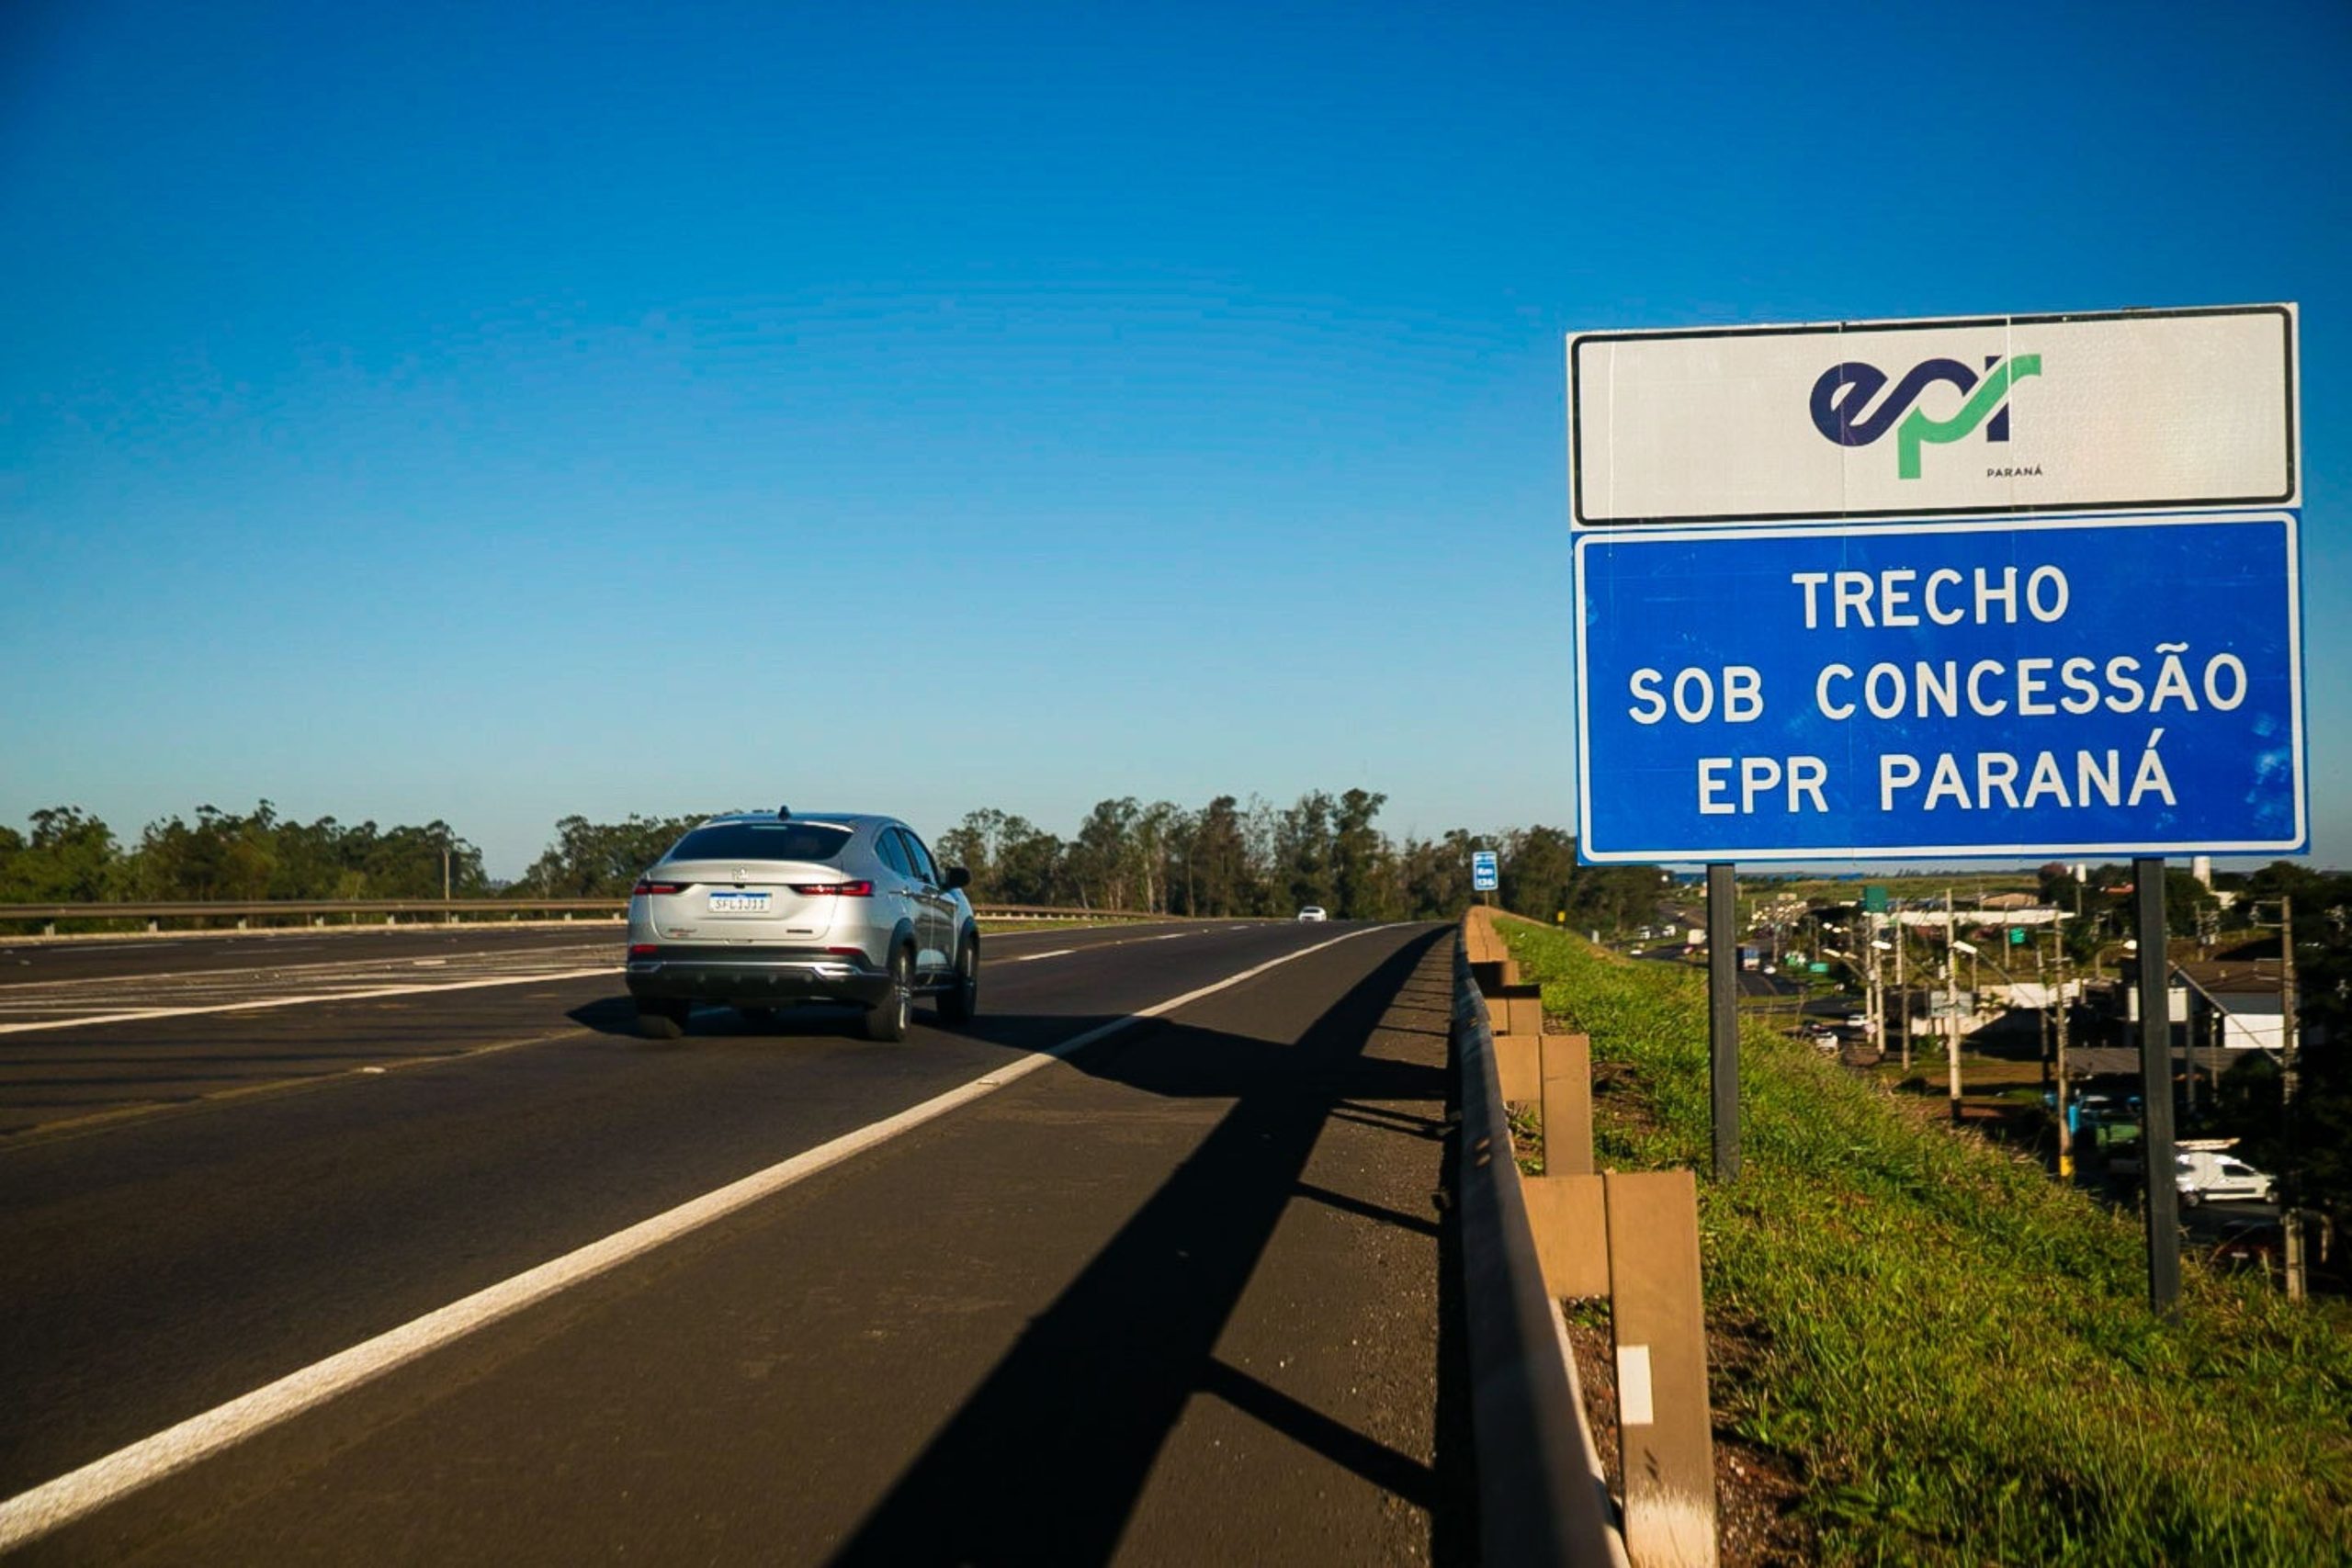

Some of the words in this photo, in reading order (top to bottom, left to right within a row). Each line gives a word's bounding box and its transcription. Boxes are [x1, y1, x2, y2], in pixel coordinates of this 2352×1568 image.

[1987, 463, 2043, 478] PARANÁ
[1792, 565, 2069, 628] TRECHO
[1629, 666, 1763, 725] SOB
[1816, 642, 2247, 720] CONCESSÃO
[1698, 756, 1828, 815] EPR
[1880, 728, 2177, 811] PARANÁ
